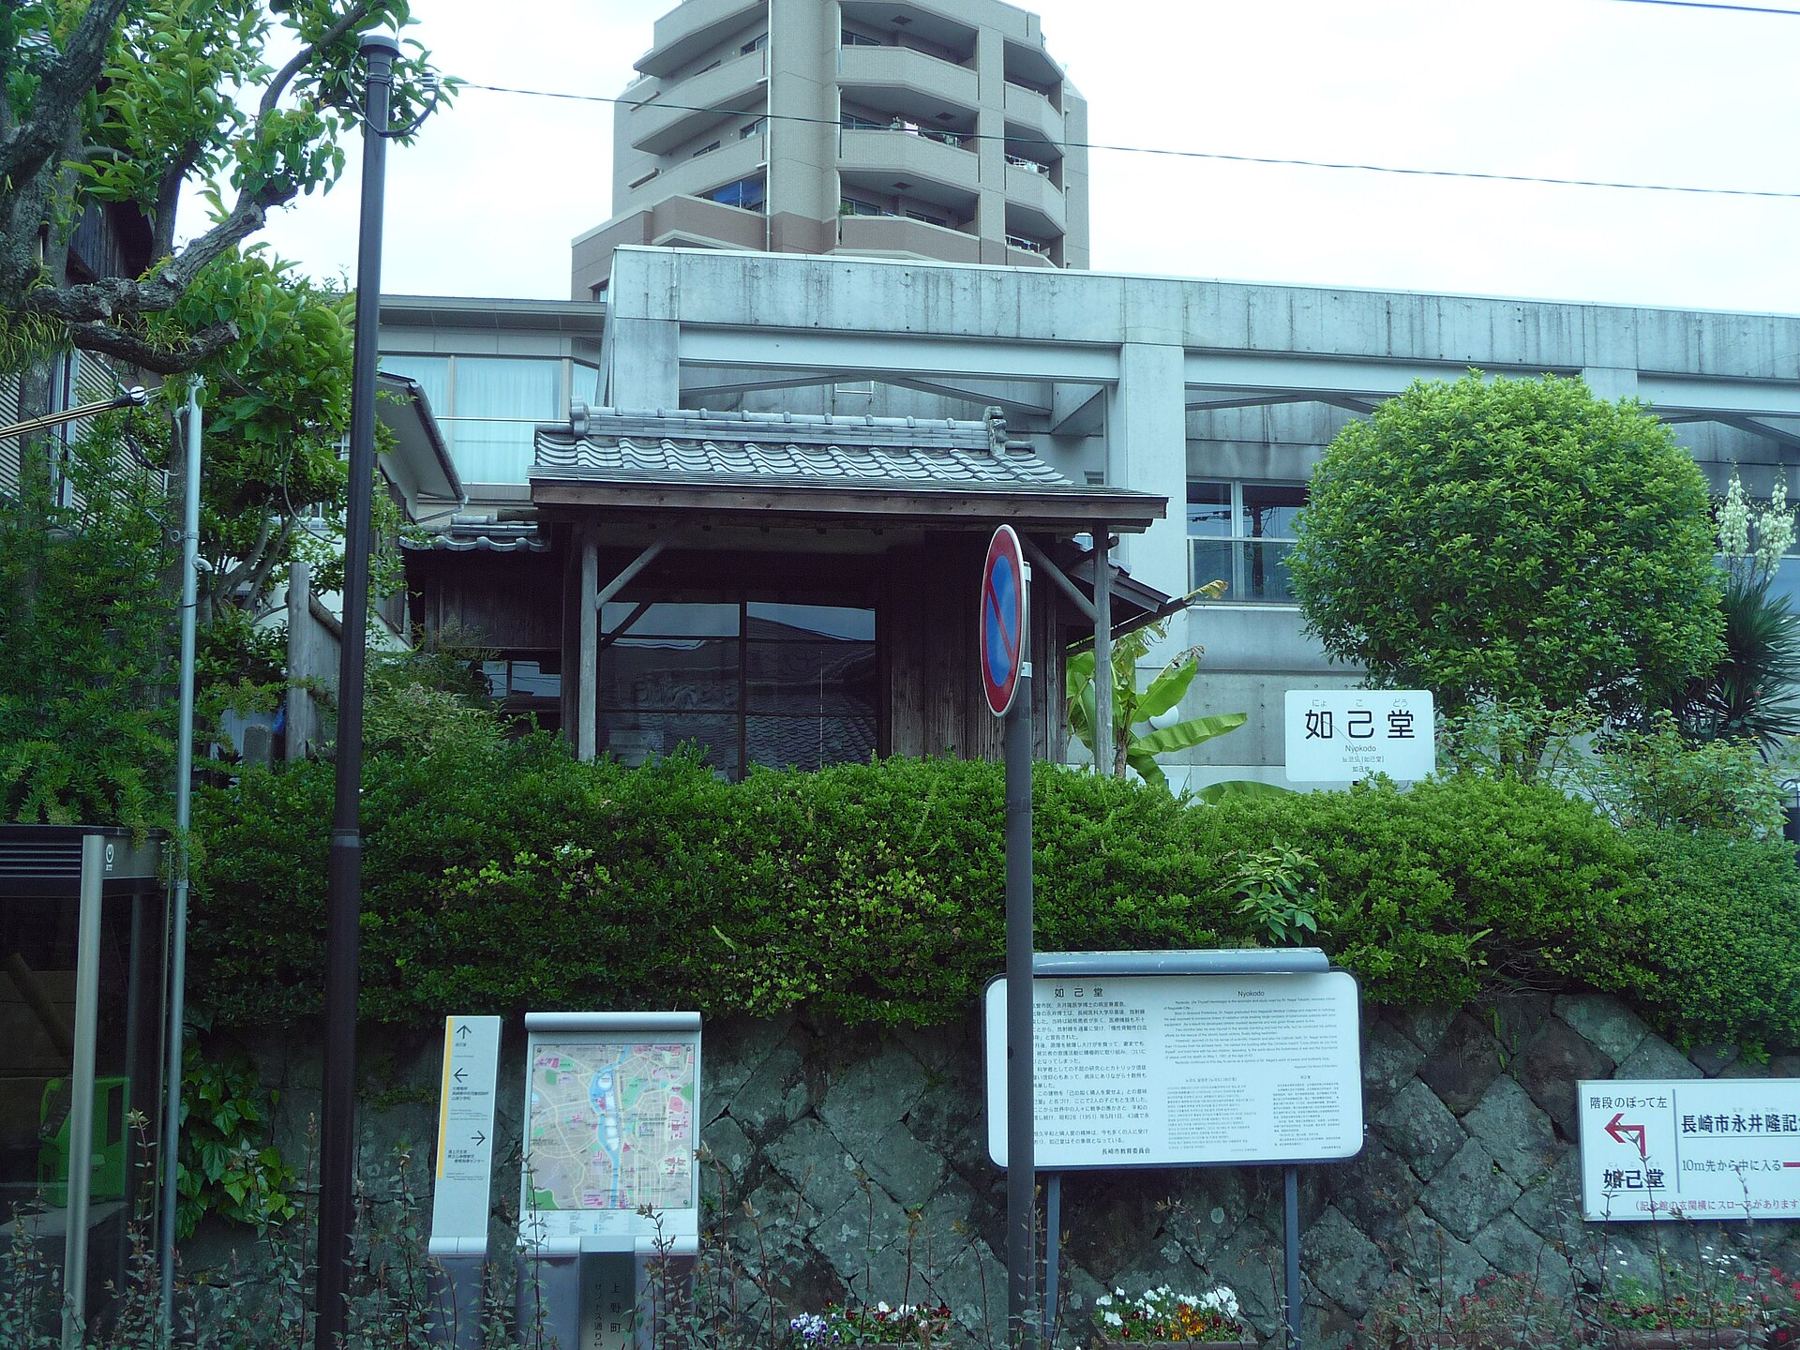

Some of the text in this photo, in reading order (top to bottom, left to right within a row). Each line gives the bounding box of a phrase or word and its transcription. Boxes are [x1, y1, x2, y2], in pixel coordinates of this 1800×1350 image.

[1305, 709, 1415, 740] 如己堂
[1344, 744, 1377, 753] Nyokodo
[1054, 987, 1104, 998] 如己堂
[1237, 989, 1265, 998] Nyokodo
[1590, 1096, 1668, 1109] 階段のぼって左
[1681, 1114, 1800, 1133] 長崎市永井隆記
[1682, 1159, 1782, 1173] 10m先から中に入る
[608, 1282, 622, 1333] 上野町
